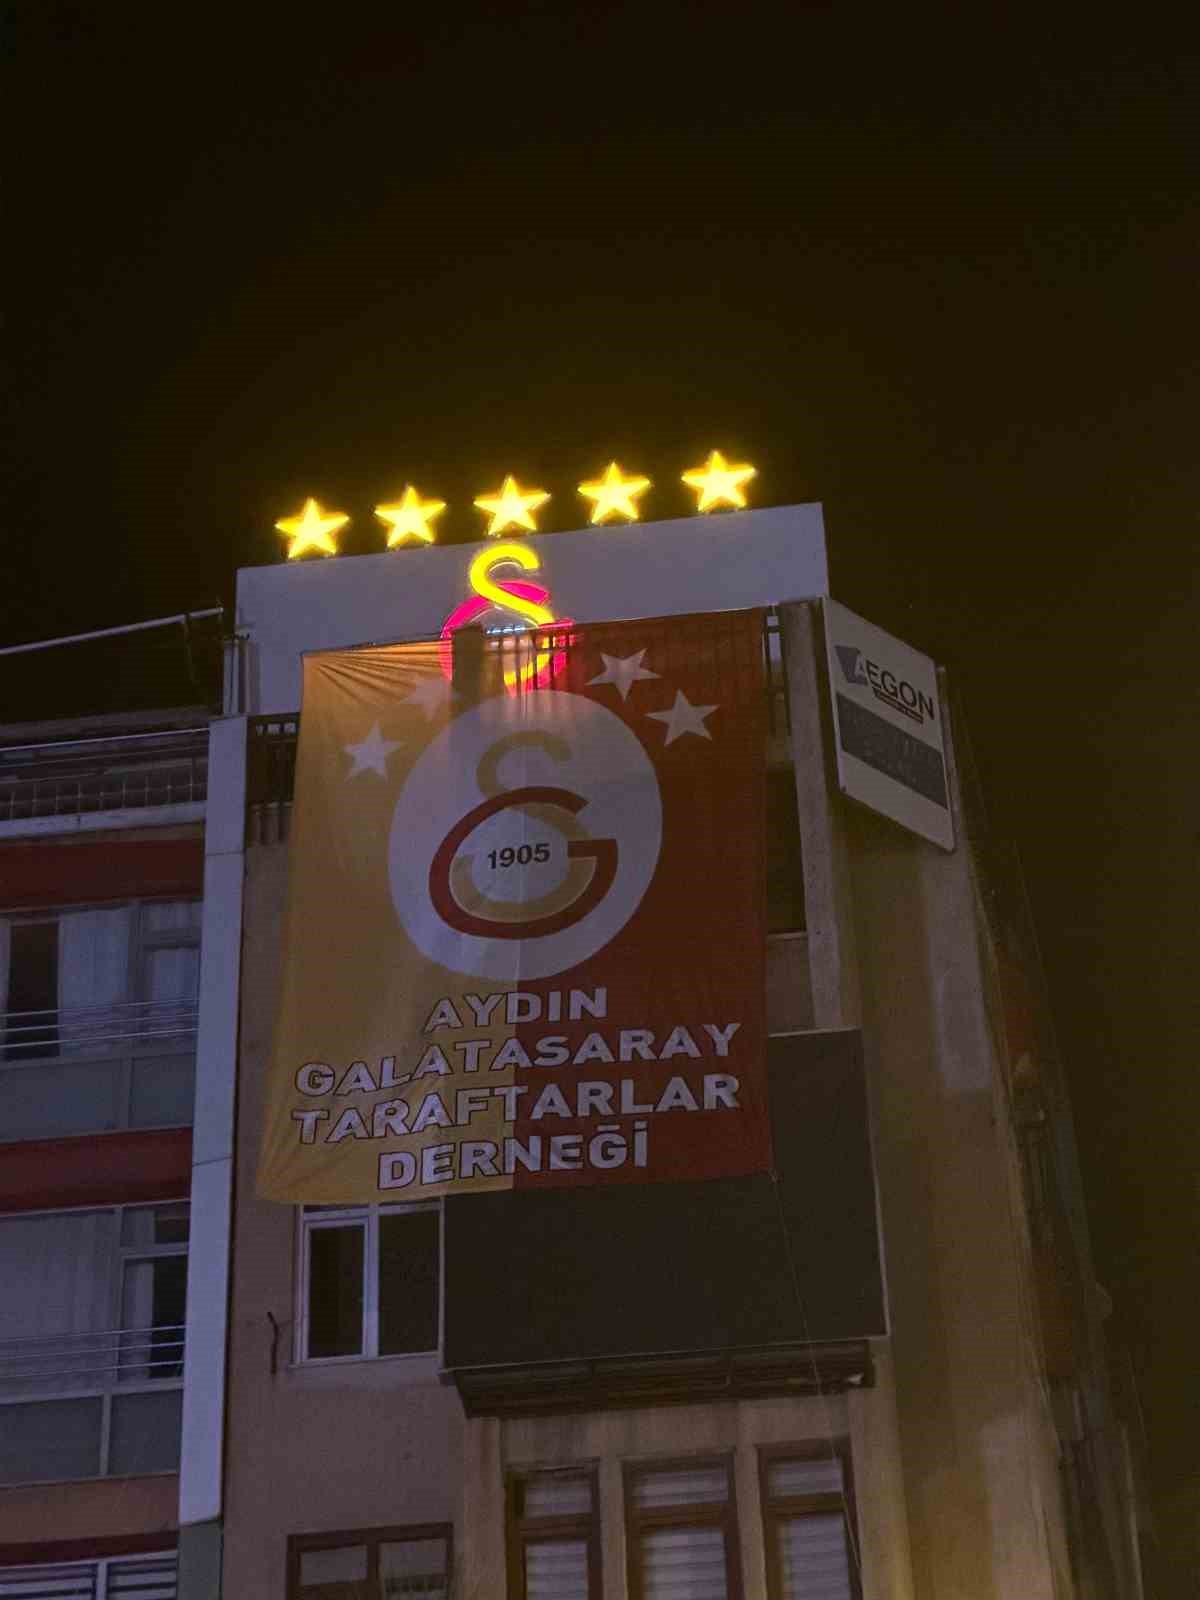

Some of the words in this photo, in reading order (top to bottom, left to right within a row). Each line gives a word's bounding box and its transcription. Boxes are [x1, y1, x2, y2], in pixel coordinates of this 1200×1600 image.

[853, 651, 934, 720] AEGON
[487, 842, 551, 870] 1905
[424, 986, 608, 1034] AYDIN
[294, 1022, 741, 1097] GALATASARAY
[291, 1072, 741, 1145] TARAFTARLAR
[376, 1120, 649, 1190] DERNEĞİ
